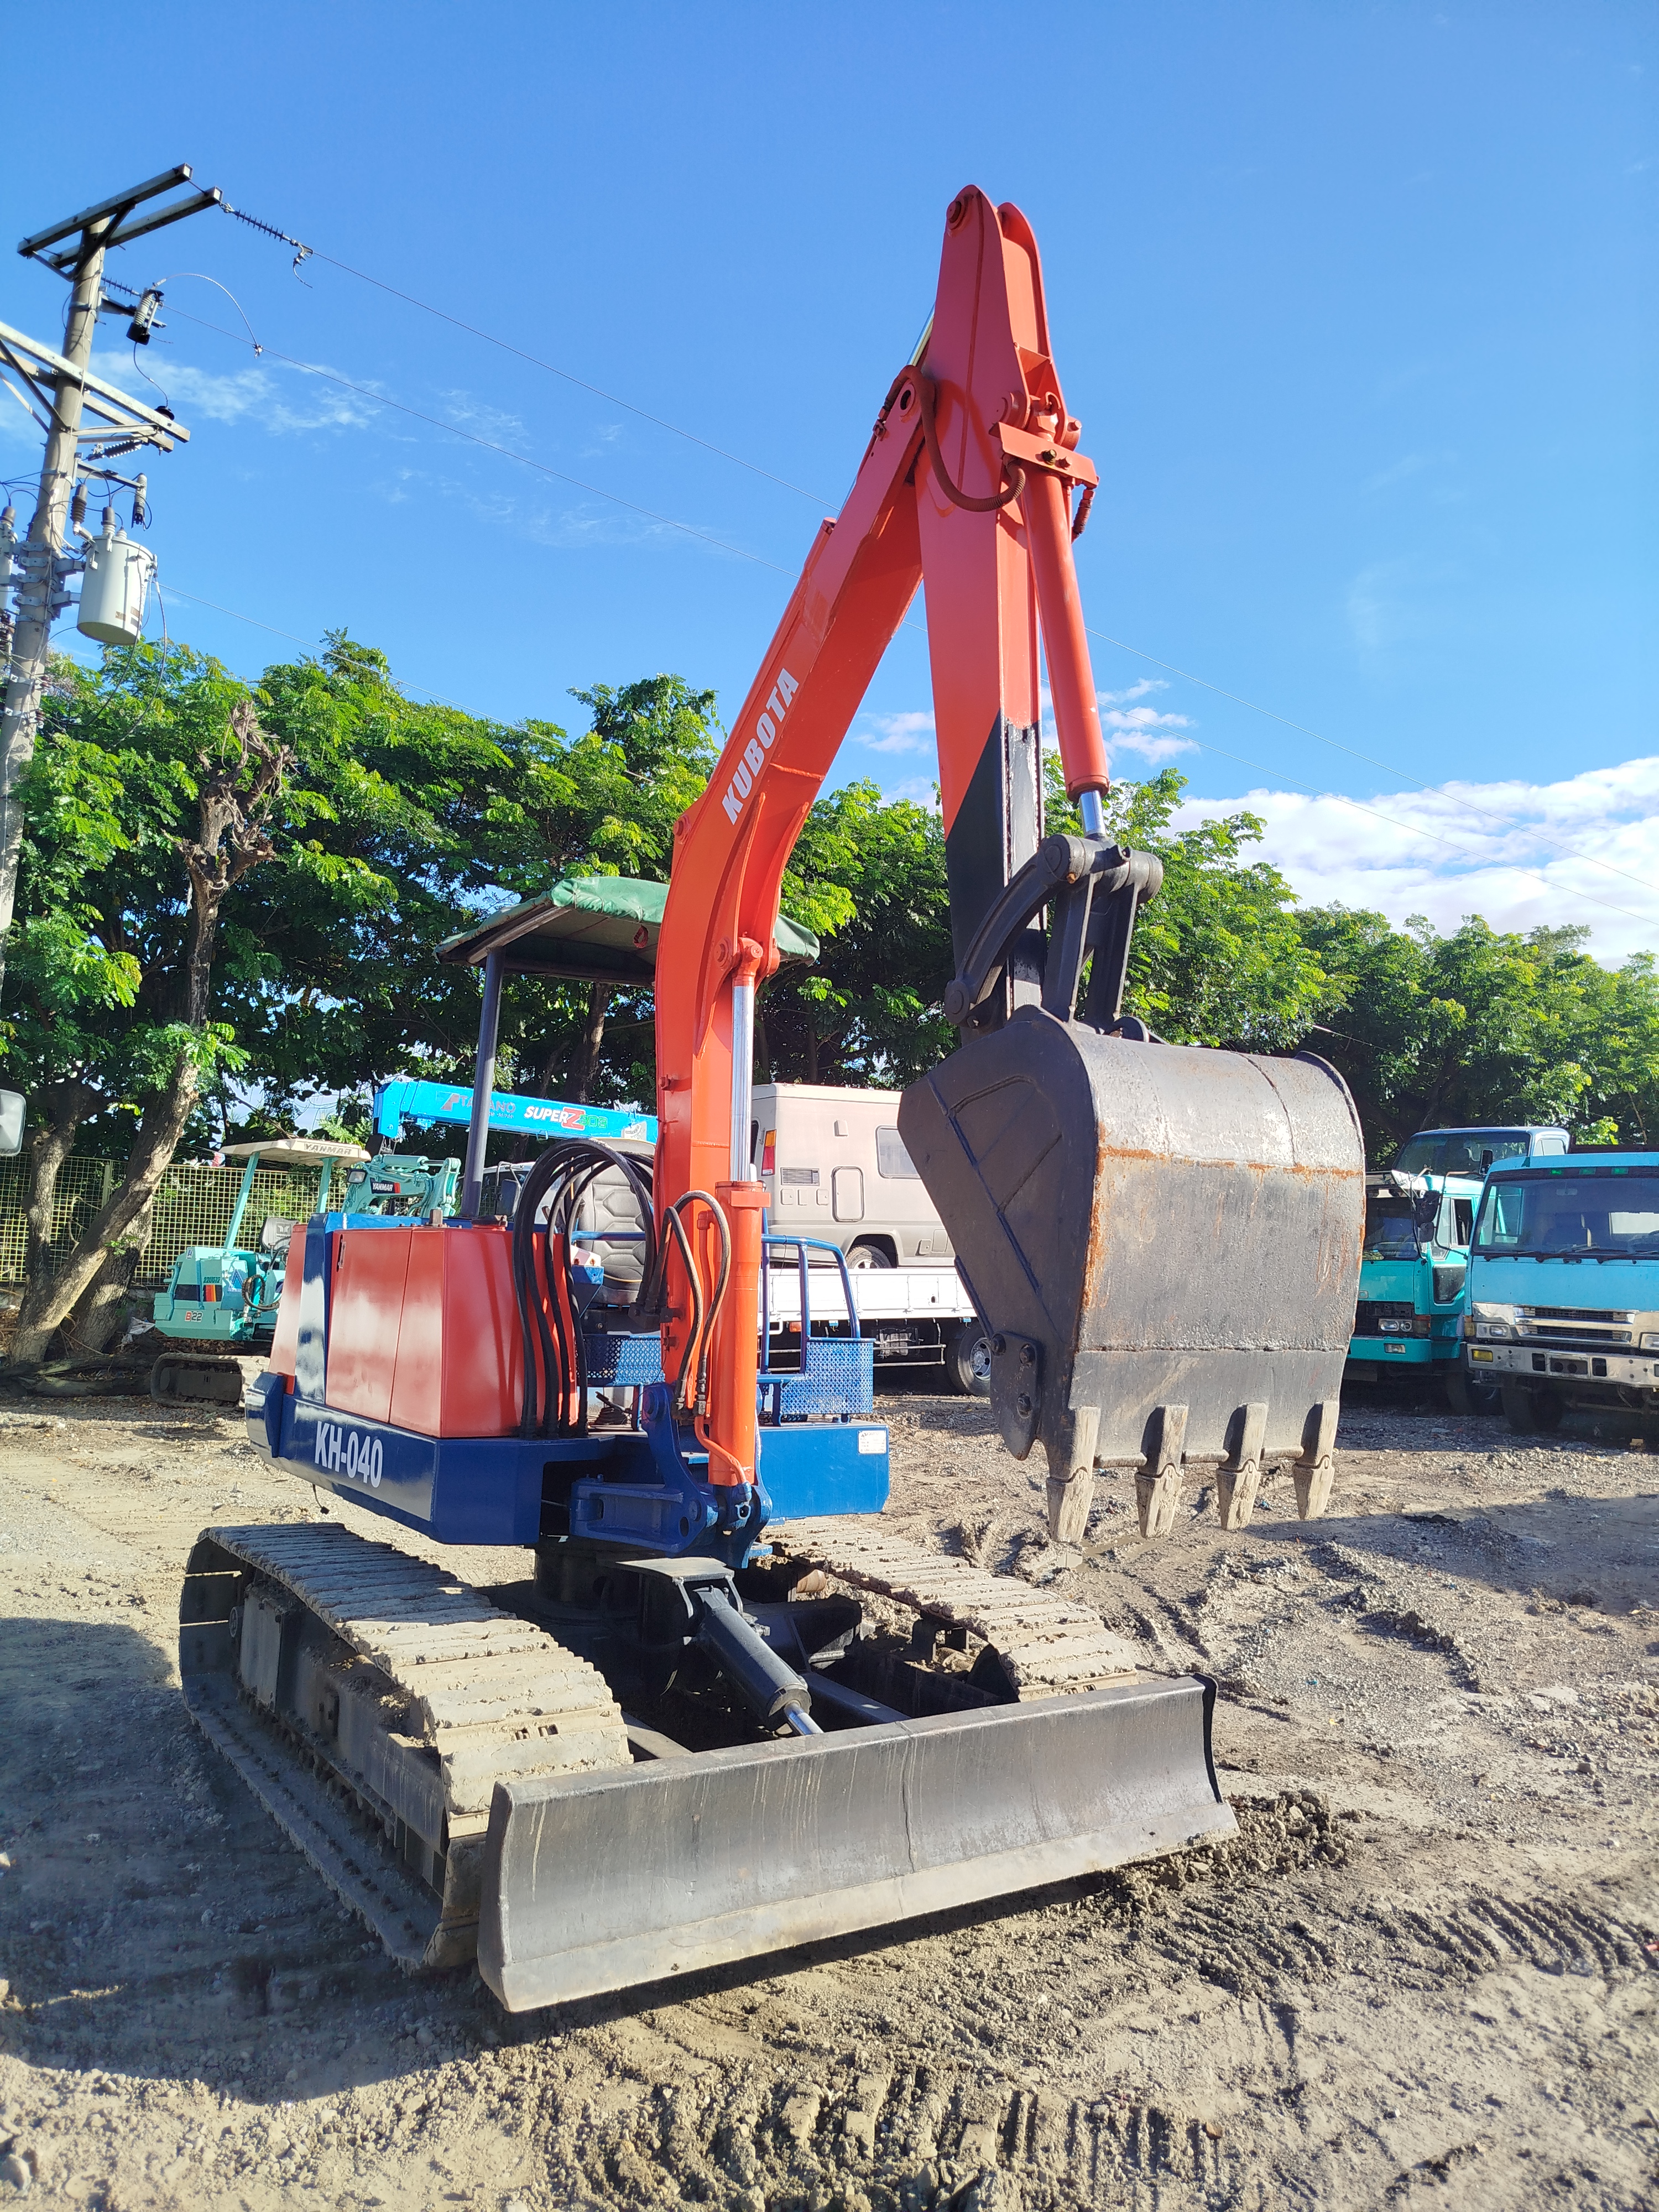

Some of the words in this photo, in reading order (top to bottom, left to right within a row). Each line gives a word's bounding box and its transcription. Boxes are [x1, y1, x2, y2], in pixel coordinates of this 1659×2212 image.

[722, 668, 799, 825] KUBOTA
[460, 1094, 516, 1113] TAANO
[305, 1143, 352, 1155] YANMAR
[372, 1183, 393, 1191] YANMAR
[185, 1311, 203, 1322] B22
[315, 1420, 383, 1488] KH-040
